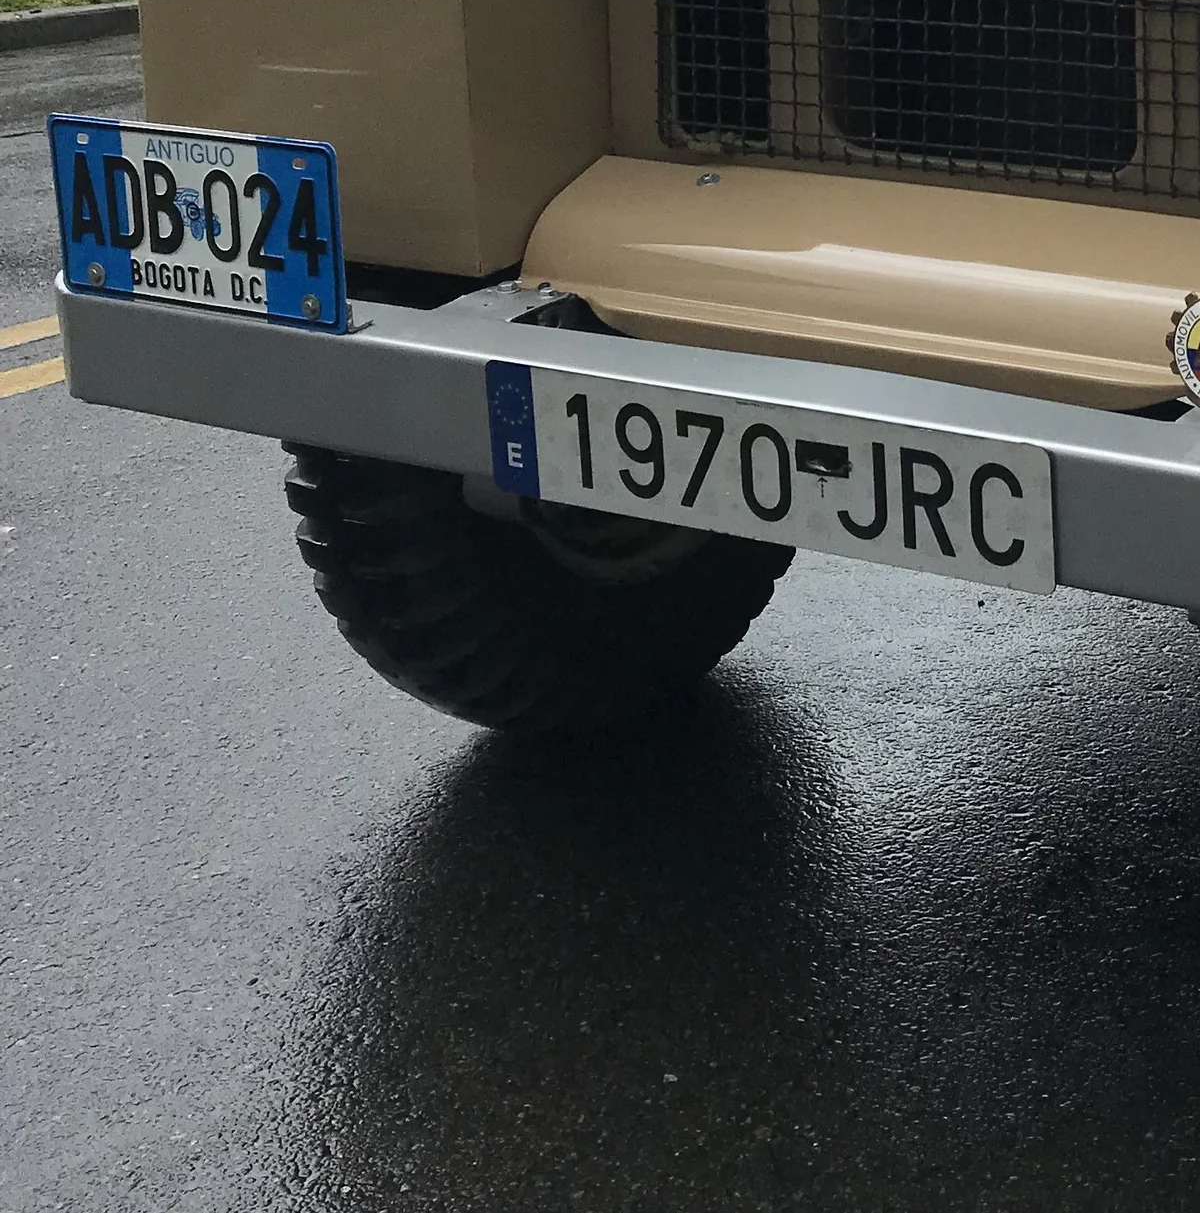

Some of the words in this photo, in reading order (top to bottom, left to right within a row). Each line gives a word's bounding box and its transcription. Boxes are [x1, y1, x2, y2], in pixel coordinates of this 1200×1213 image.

[145, 138, 235, 167] ANTIGUO
[72, 149, 185, 255] ADB
[202, 168, 328, 277] 024
[131, 258, 215, 298] BOGOTA
[1176, 310, 1199, 381] AUTOMOVIL
[507, 442, 524, 468] E
[566, 393, 793, 523] 1970
[837, 442, 1026, 567] JRC
